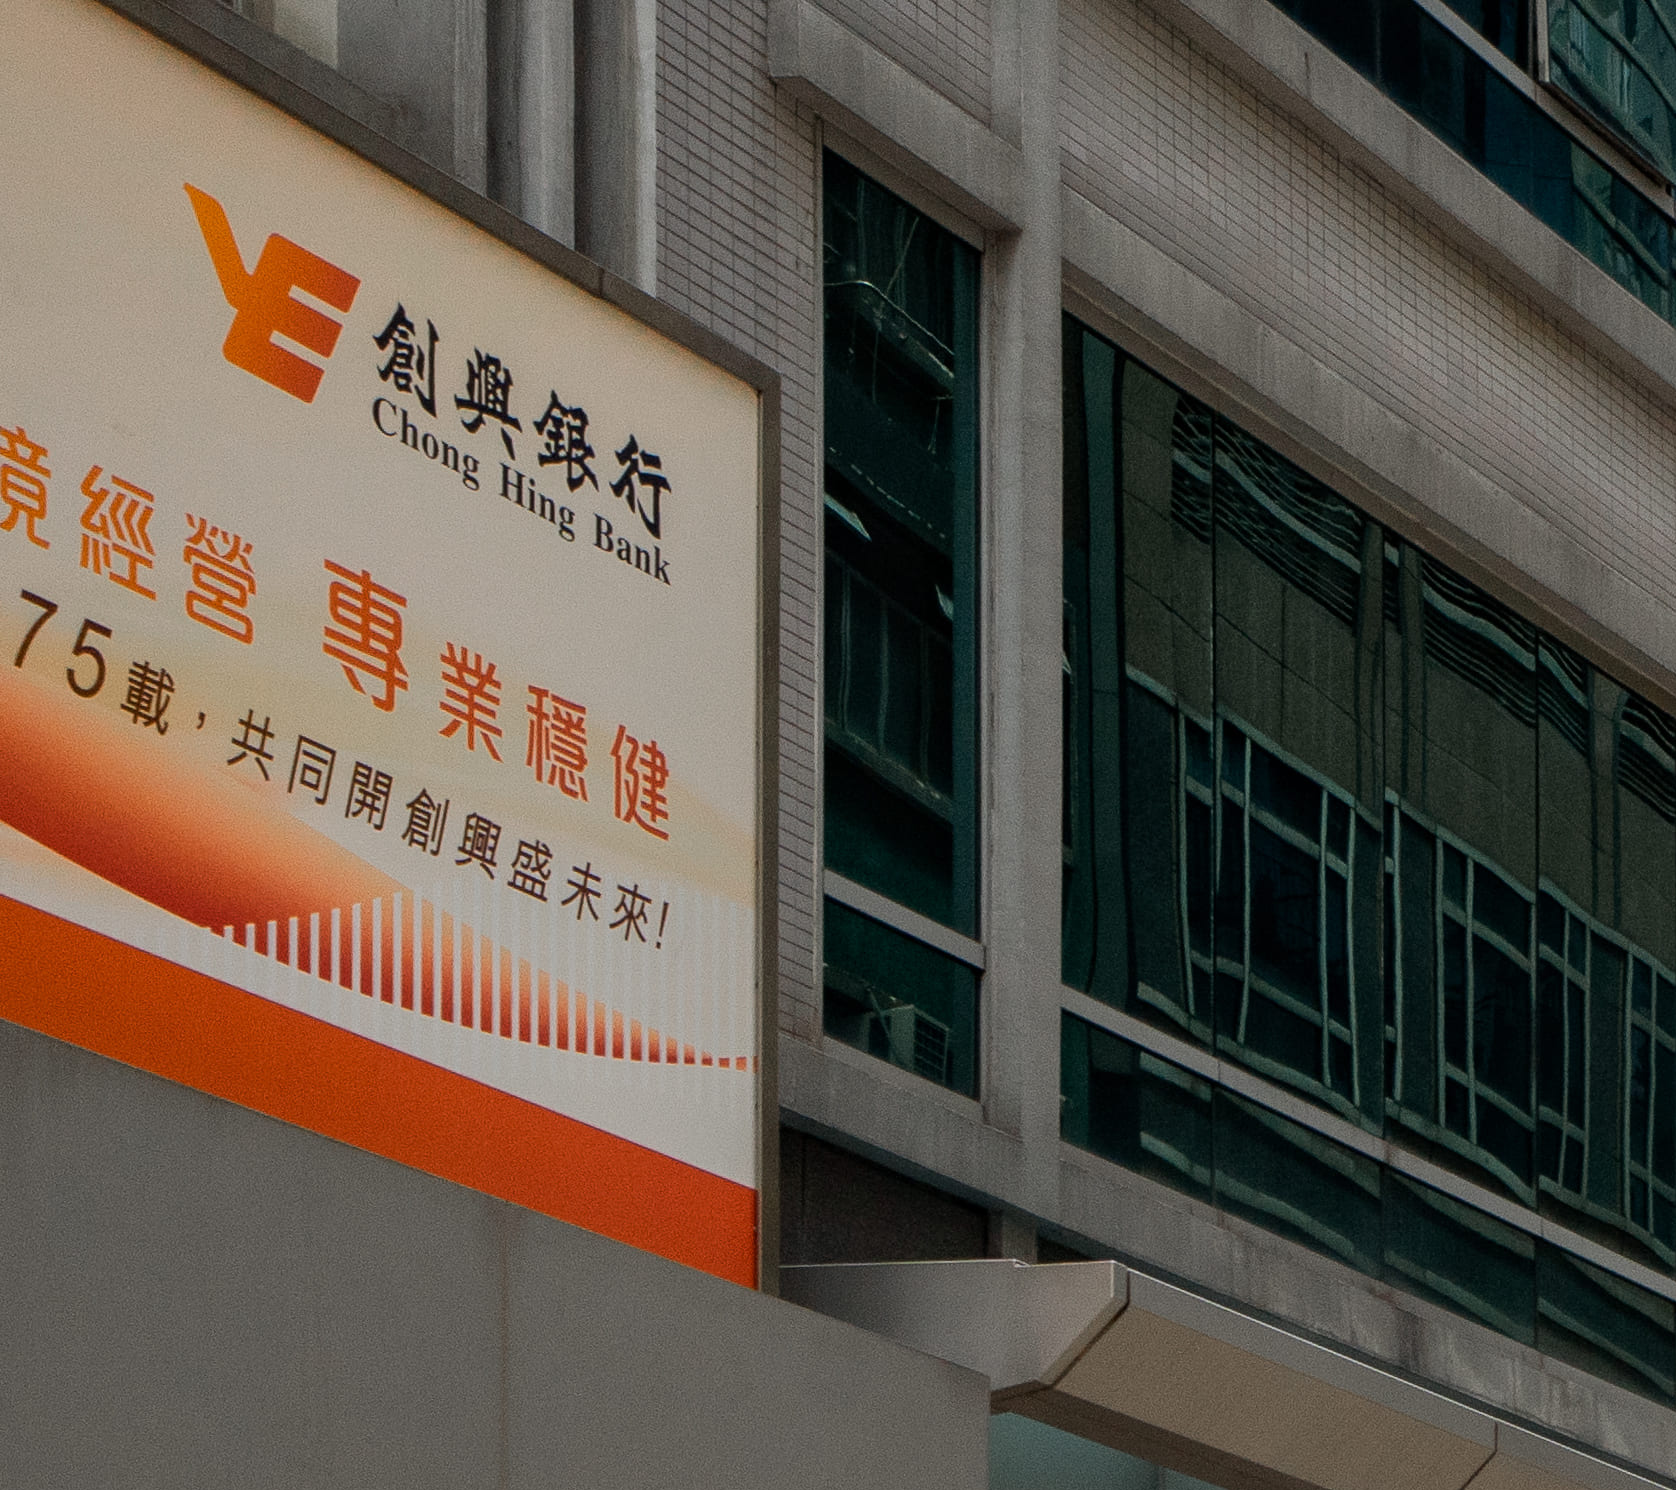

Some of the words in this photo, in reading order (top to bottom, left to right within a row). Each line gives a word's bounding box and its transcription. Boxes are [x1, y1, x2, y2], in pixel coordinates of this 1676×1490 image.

[371, 395, 481, 494] Chong
[498, 464, 576, 542] Hing
[592, 510, 671, 585] Bank
[373, 306, 671, 540] 創興銀行
[321, 557, 671, 840] 專業穩健
